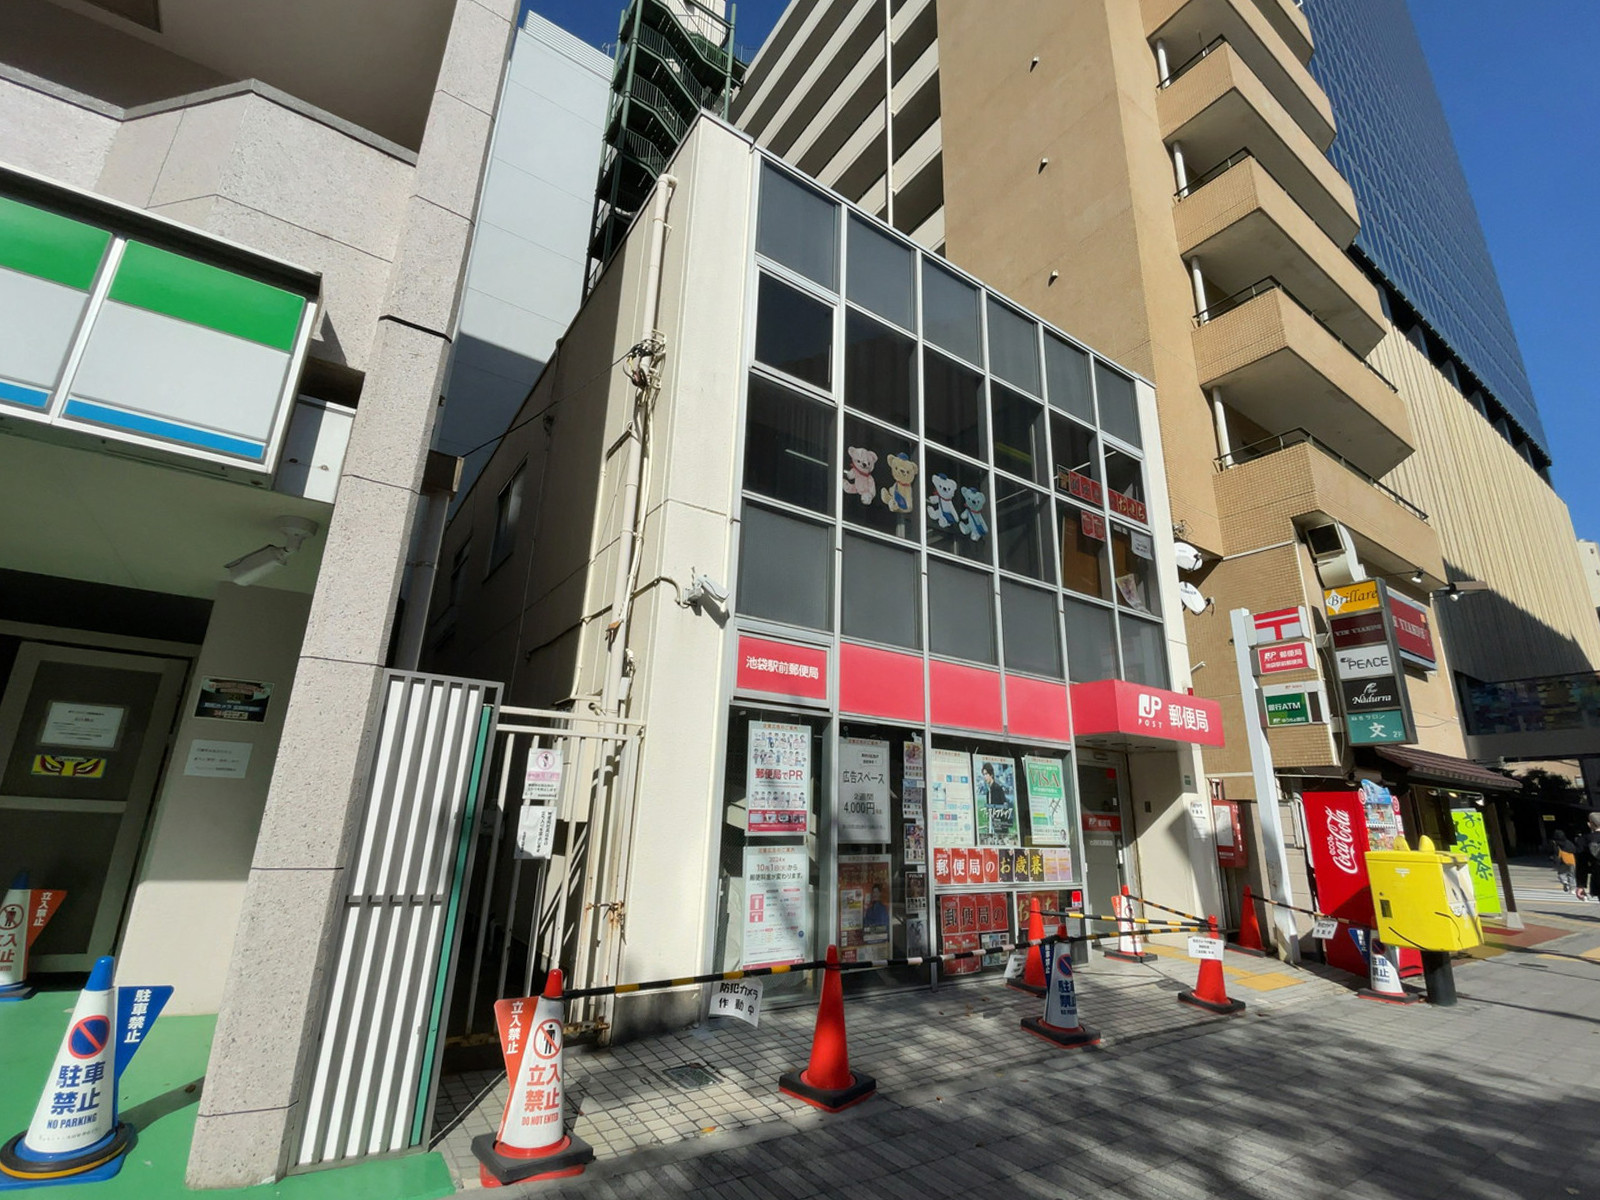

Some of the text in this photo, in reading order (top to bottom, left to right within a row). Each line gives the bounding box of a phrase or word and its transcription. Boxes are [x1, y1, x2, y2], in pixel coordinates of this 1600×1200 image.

[1328, 589, 1378, 606] Brillare
[746, 655, 819, 680] 池袋駅前郵便局
[1348, 657, 1389, 670] PEACE
[1138, 693, 1162, 718] JP
[1267, 702, 1301, 712] 銀行ATM
[1138, 718, 1163, 728] POST
[1168, 703, 1209, 733] 郵便局
[1368, 721, 1388, 739] 文
[1393, 730, 1403, 739] 2F
[755, 767, 804, 781] 郵便局でPR
[842, 769, 885, 785] 広告スペース
[1324, 805, 1359, 875] Coca-Cola
[33, 891, 53, 927] 立入禁止
[719, 982, 759, 1001] 防犯カメラ
[124, 989, 153, 1043] 駐車禁止
[719, 997, 755, 1016] 作動中
[506, 1000, 524, 1055] 立入禁止
[56, 1061, 106, 1088] 駐車
[526, 1063, 561, 1086] 立入
[50, 1087, 101, 1115] 禁止
[524, 1087, 560, 1112] 禁止
[46, 1113, 98, 1129] NO PARKING
[521, 1116, 530, 1126] DO
[531, 1115, 544, 1125] NOT
